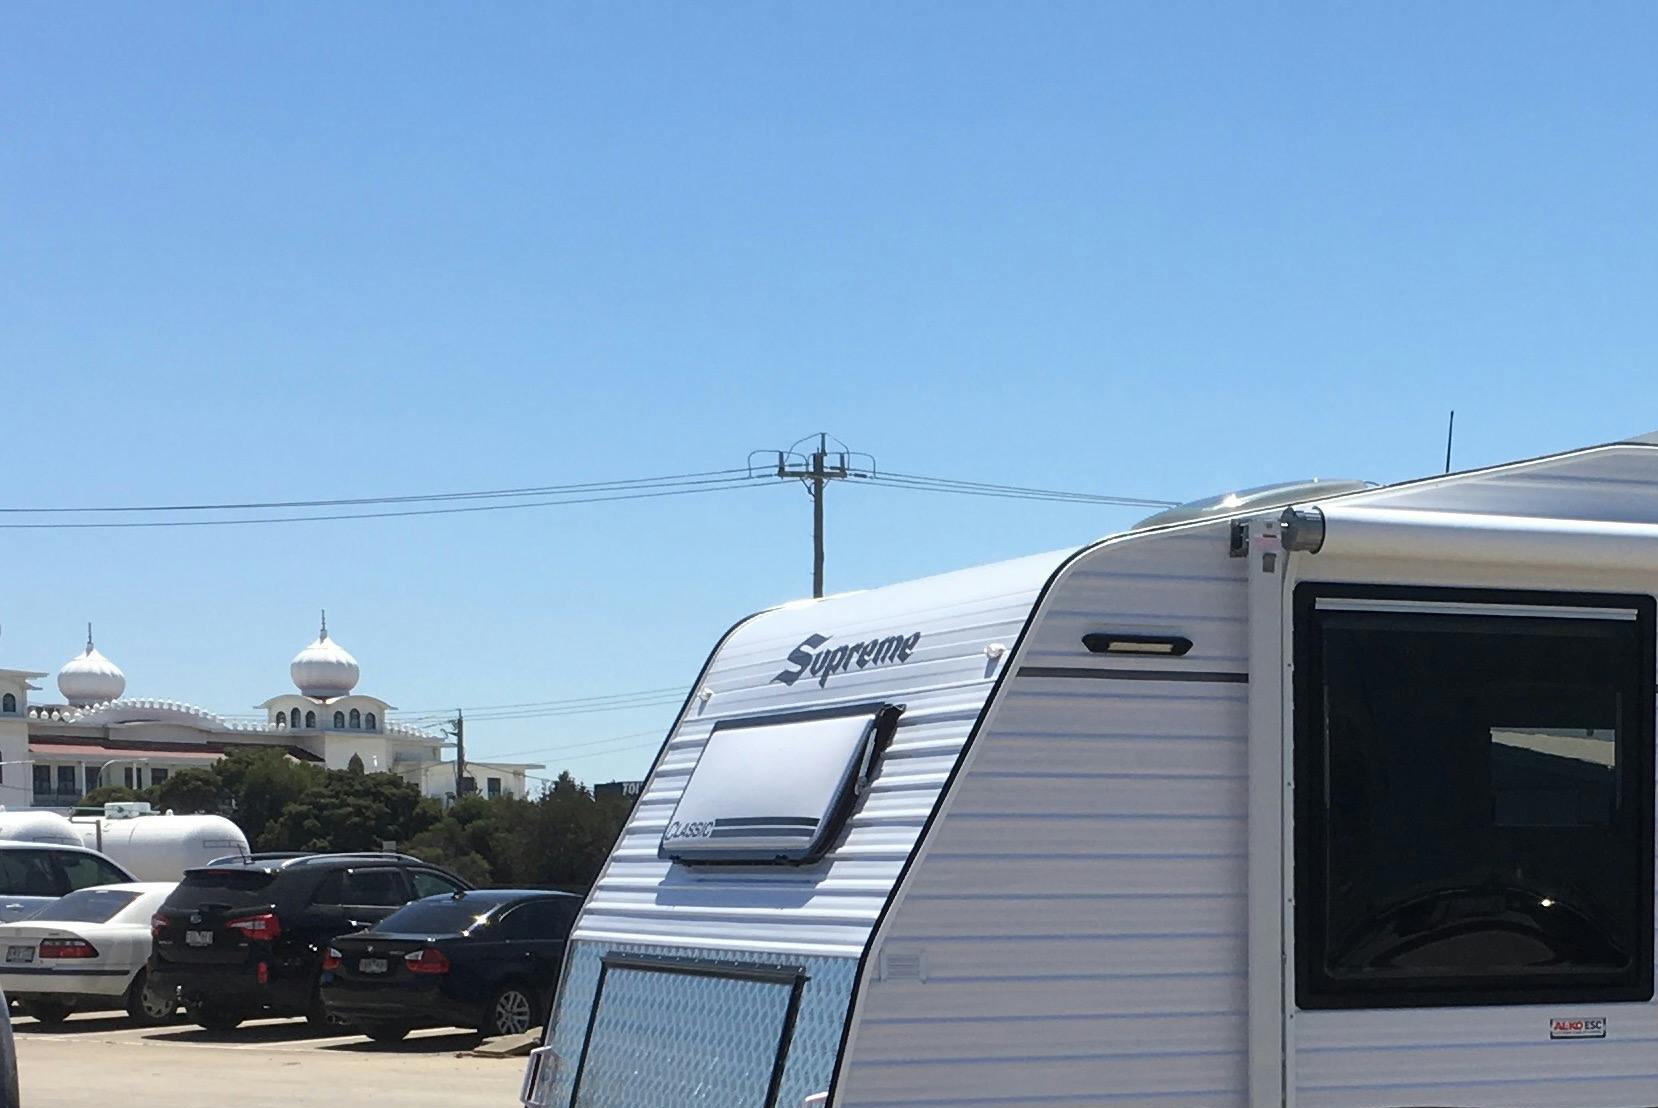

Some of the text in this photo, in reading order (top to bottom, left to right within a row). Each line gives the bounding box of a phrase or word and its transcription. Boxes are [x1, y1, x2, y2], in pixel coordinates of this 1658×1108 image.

[769, 632, 921, 689] Supreme
[664, 820, 715, 841] CLASSIC
[1585, 1020, 1602, 1030] ESC
